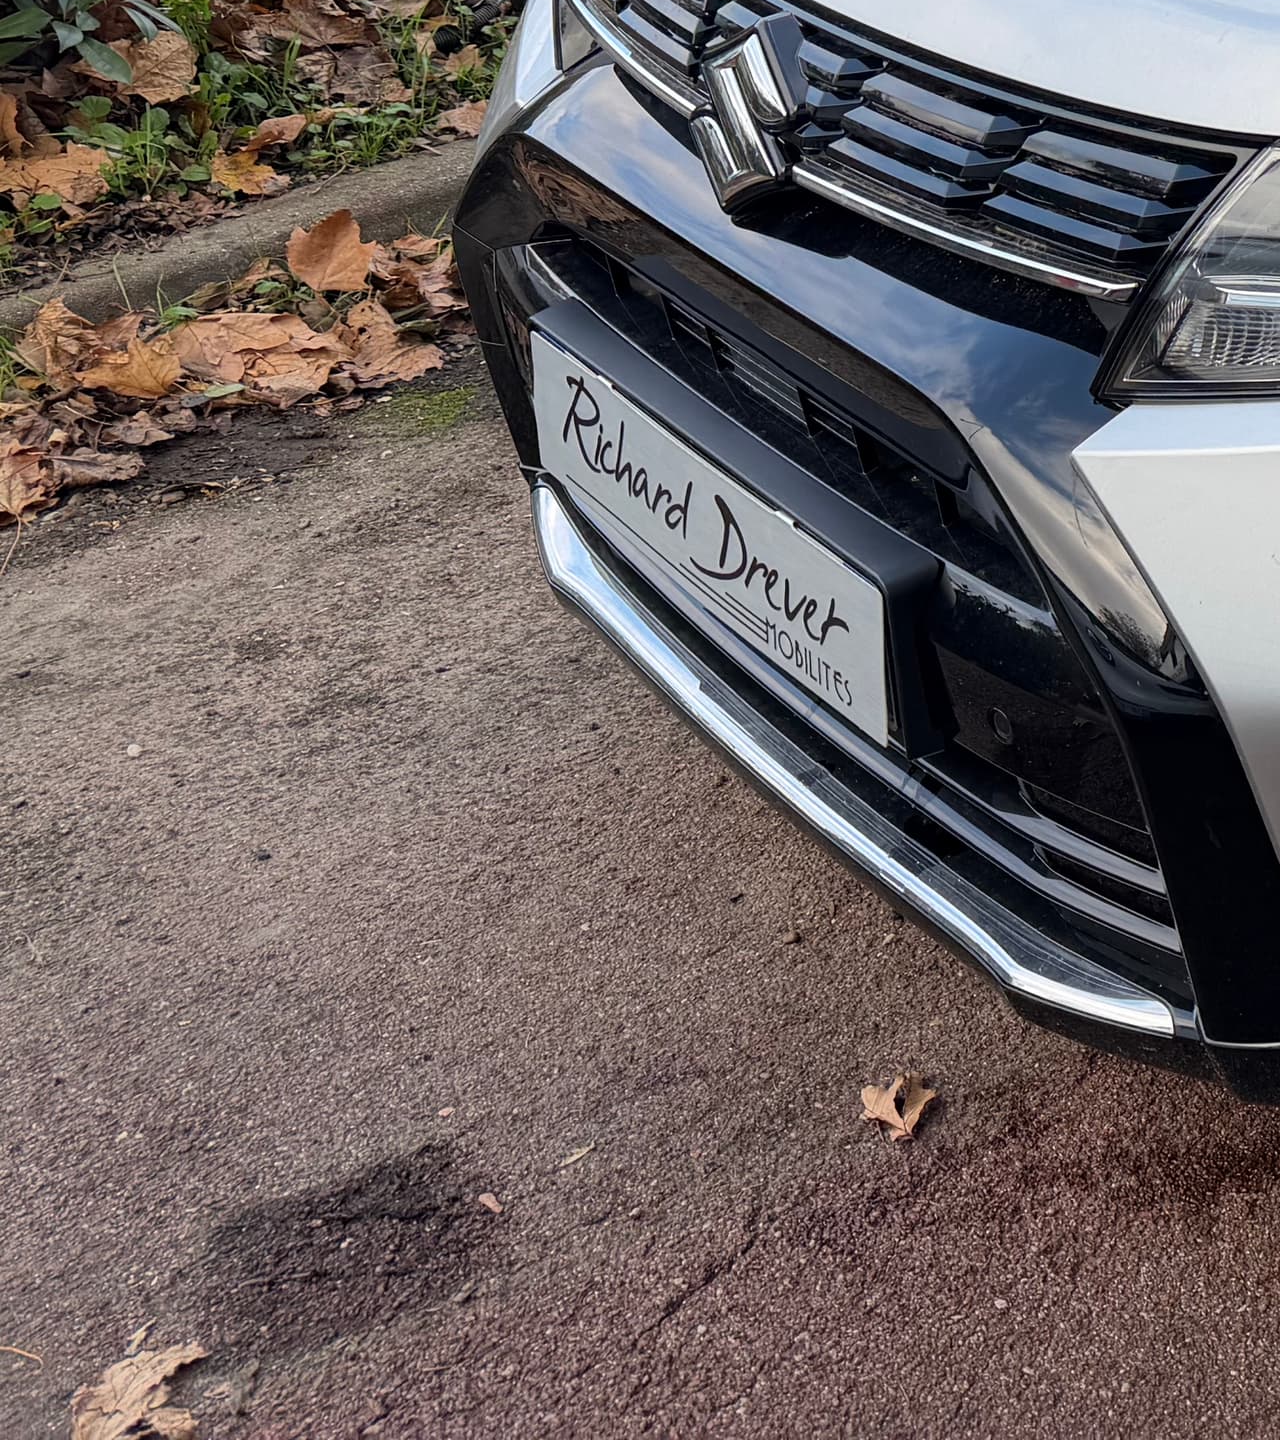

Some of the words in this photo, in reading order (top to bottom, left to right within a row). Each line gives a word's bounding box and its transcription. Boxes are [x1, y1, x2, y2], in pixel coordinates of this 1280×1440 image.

[563, 375, 693, 539] Richard
[689, 494, 849, 645] Drevet
[765, 616, 854, 707] MOBILITES
